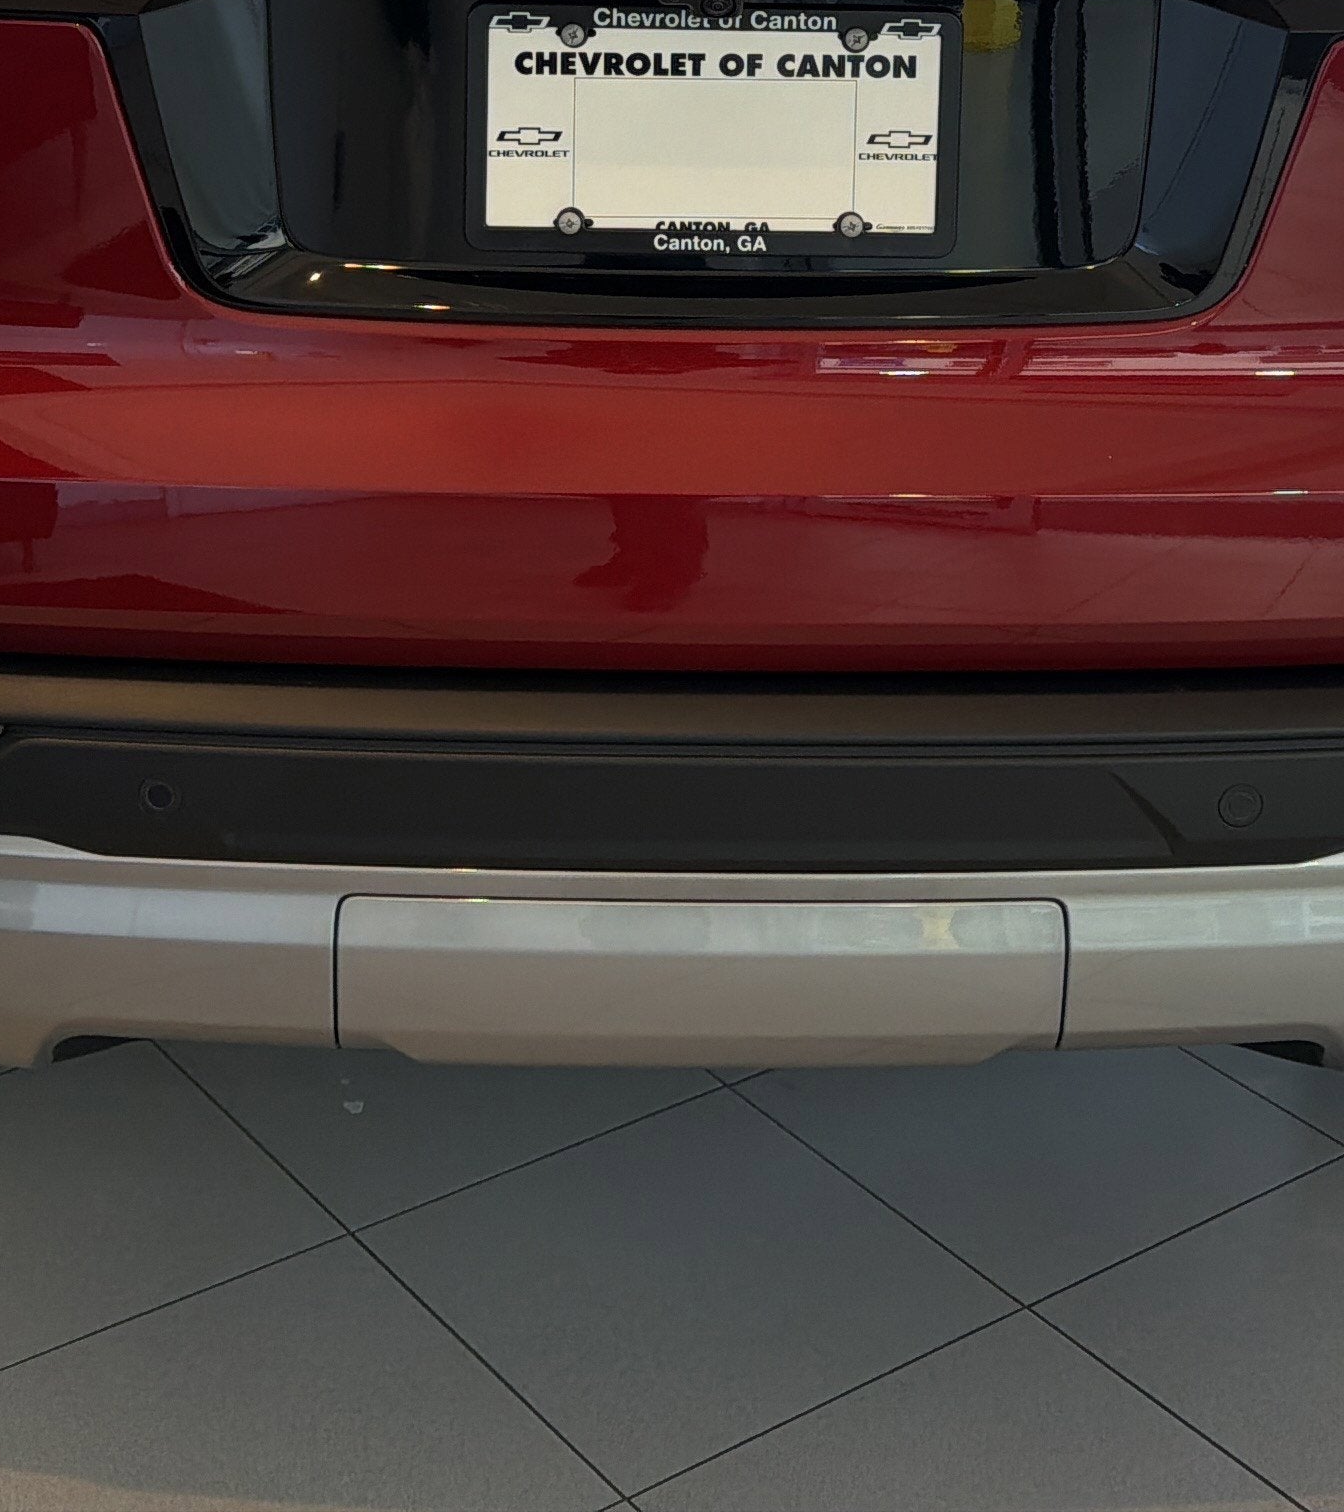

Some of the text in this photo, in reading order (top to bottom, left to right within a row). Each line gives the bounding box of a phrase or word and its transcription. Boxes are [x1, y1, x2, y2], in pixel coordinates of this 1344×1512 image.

[750, 10, 837, 30] Canton
[514, 51, 917, 78] CHEVROLET OF CANTON
[488, 149, 570, 158] CHEVROLET
[653, 233, 767, 254] Canton, GA
